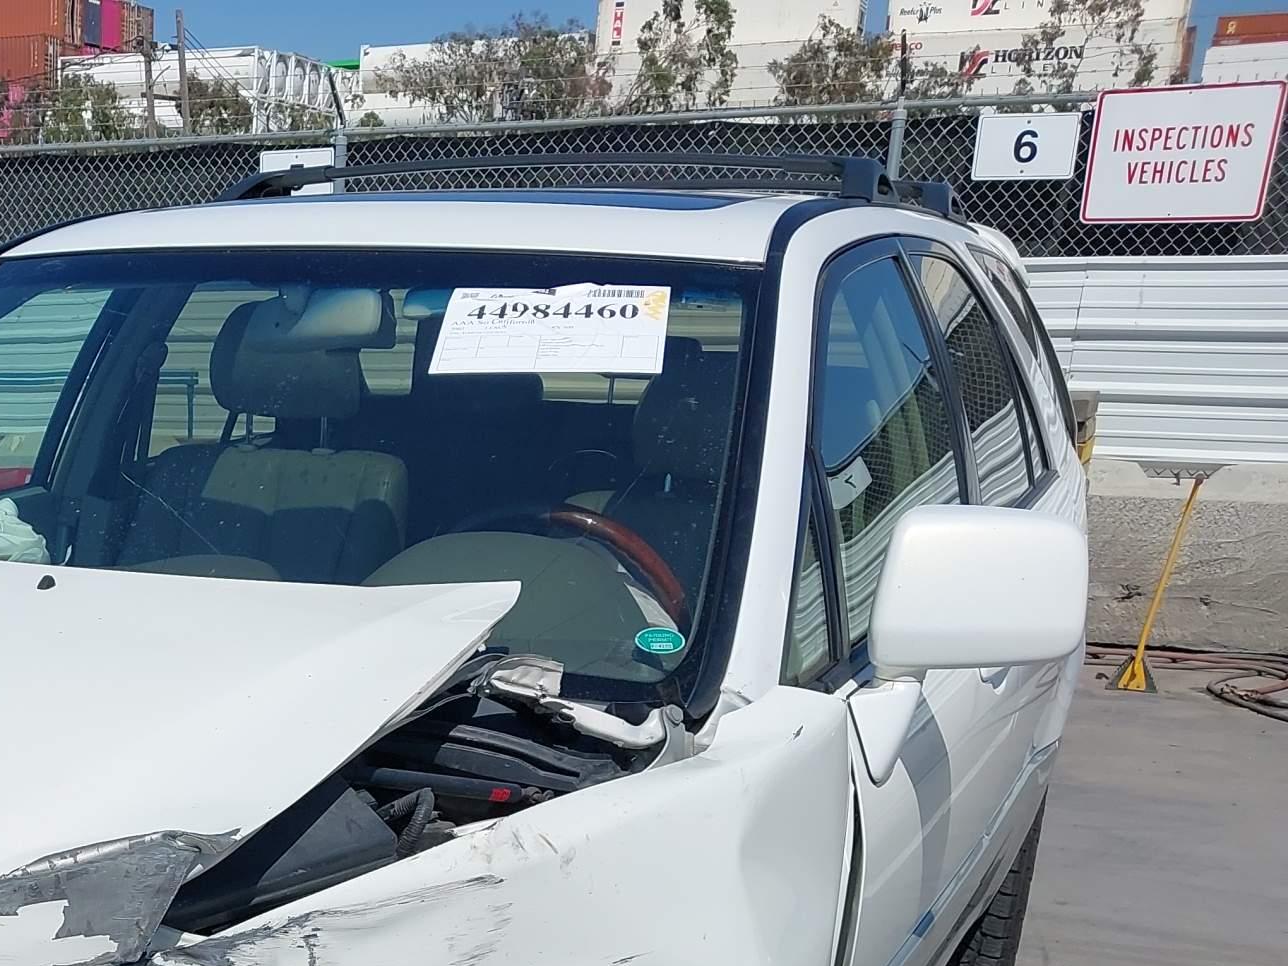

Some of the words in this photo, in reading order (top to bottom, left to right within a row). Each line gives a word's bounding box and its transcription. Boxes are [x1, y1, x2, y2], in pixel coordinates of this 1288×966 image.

[930, 6, 943, 14] Plus
[1014, 130, 1038, 163] 6
[1113, 123, 1255, 152] INSPECTIONS
[1127, 159, 1228, 184] VEHICLES
[467, 302, 639, 319] 44984460
